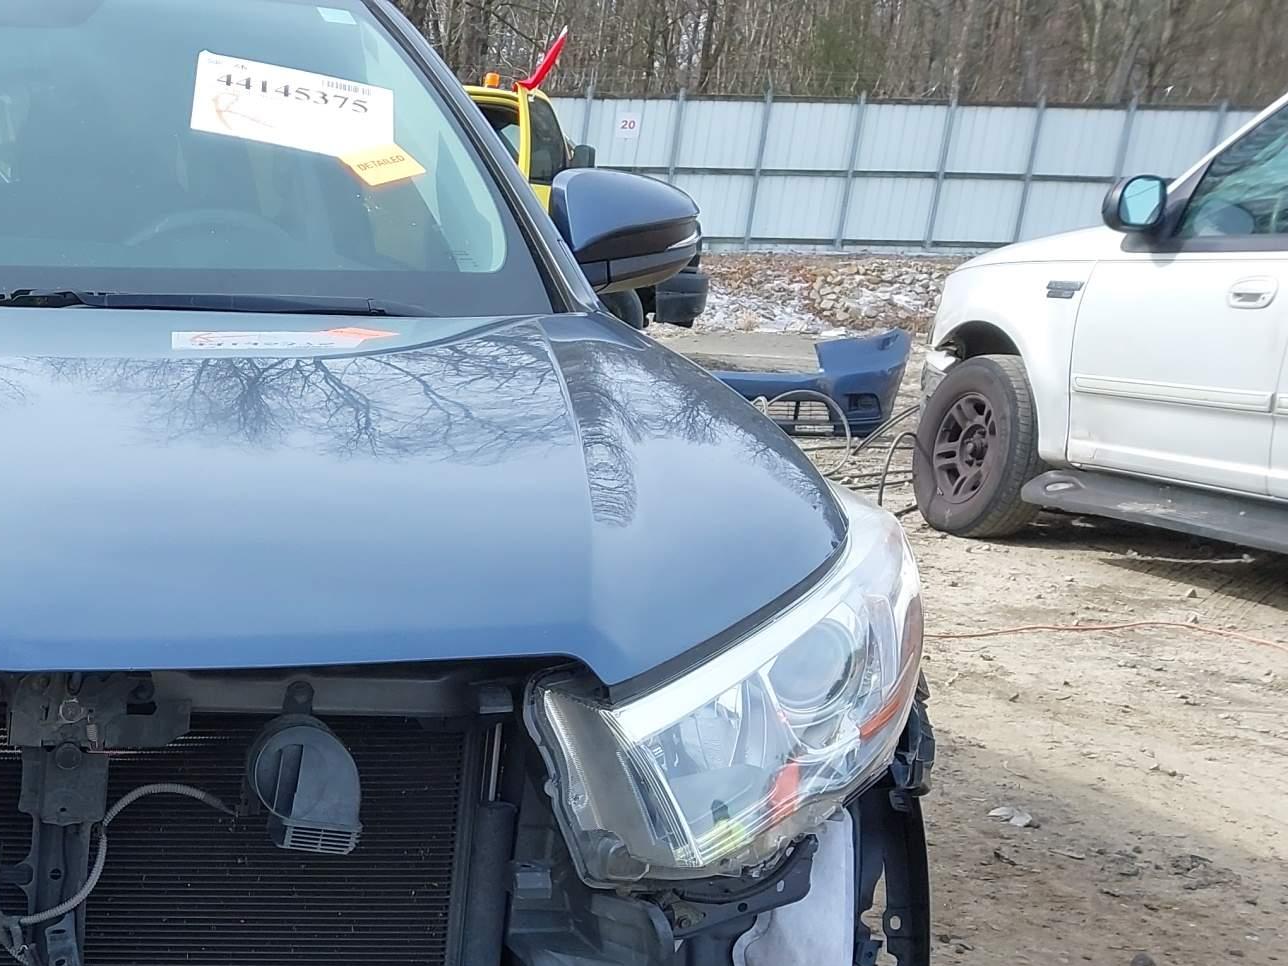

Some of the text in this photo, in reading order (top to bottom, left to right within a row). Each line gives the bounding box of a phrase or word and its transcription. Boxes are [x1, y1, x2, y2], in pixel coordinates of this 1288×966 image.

[216, 73, 369, 113] 44145375
[621, 119, 636, 130] 20
[357, 154, 405, 171] DETAILED
